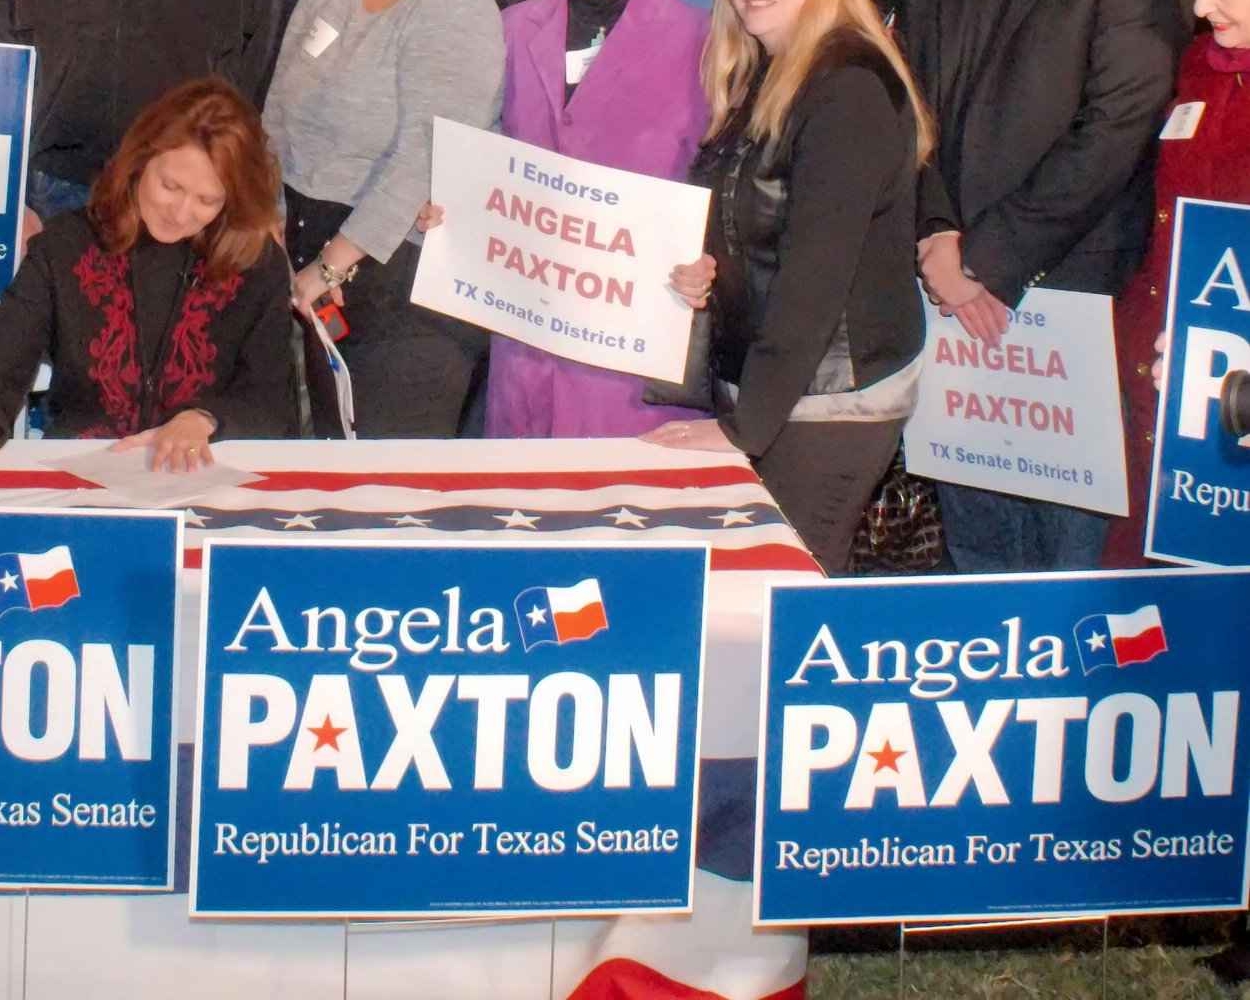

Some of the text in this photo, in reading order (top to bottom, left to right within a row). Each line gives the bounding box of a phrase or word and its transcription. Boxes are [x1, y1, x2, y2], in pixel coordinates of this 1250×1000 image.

[508, 156, 620, 206] I Endorse
[485, 187, 636, 257] ANGELA
[486, 236, 635, 308] PAXTON
[453, 278, 646, 354] TX Senate District 8
[1006, 308, 1046, 327] orse
[935, 336, 1068, 380] ANGELA
[945, 389, 1074, 436] PAXTON
[929, 442, 1094, 486] TX Senate District 8
[223, 585, 510, 672] Angela
[784, 616, 1070, 698] Angela
[216, 672, 682, 792] PAXTON
[779, 690, 1240, 812] PAXTON
[52, 792, 156, 828] Senate
[213, 820, 680, 864] Republican For Texas Senate
[775, 829, 1235, 876] Republican For Texas Senate
